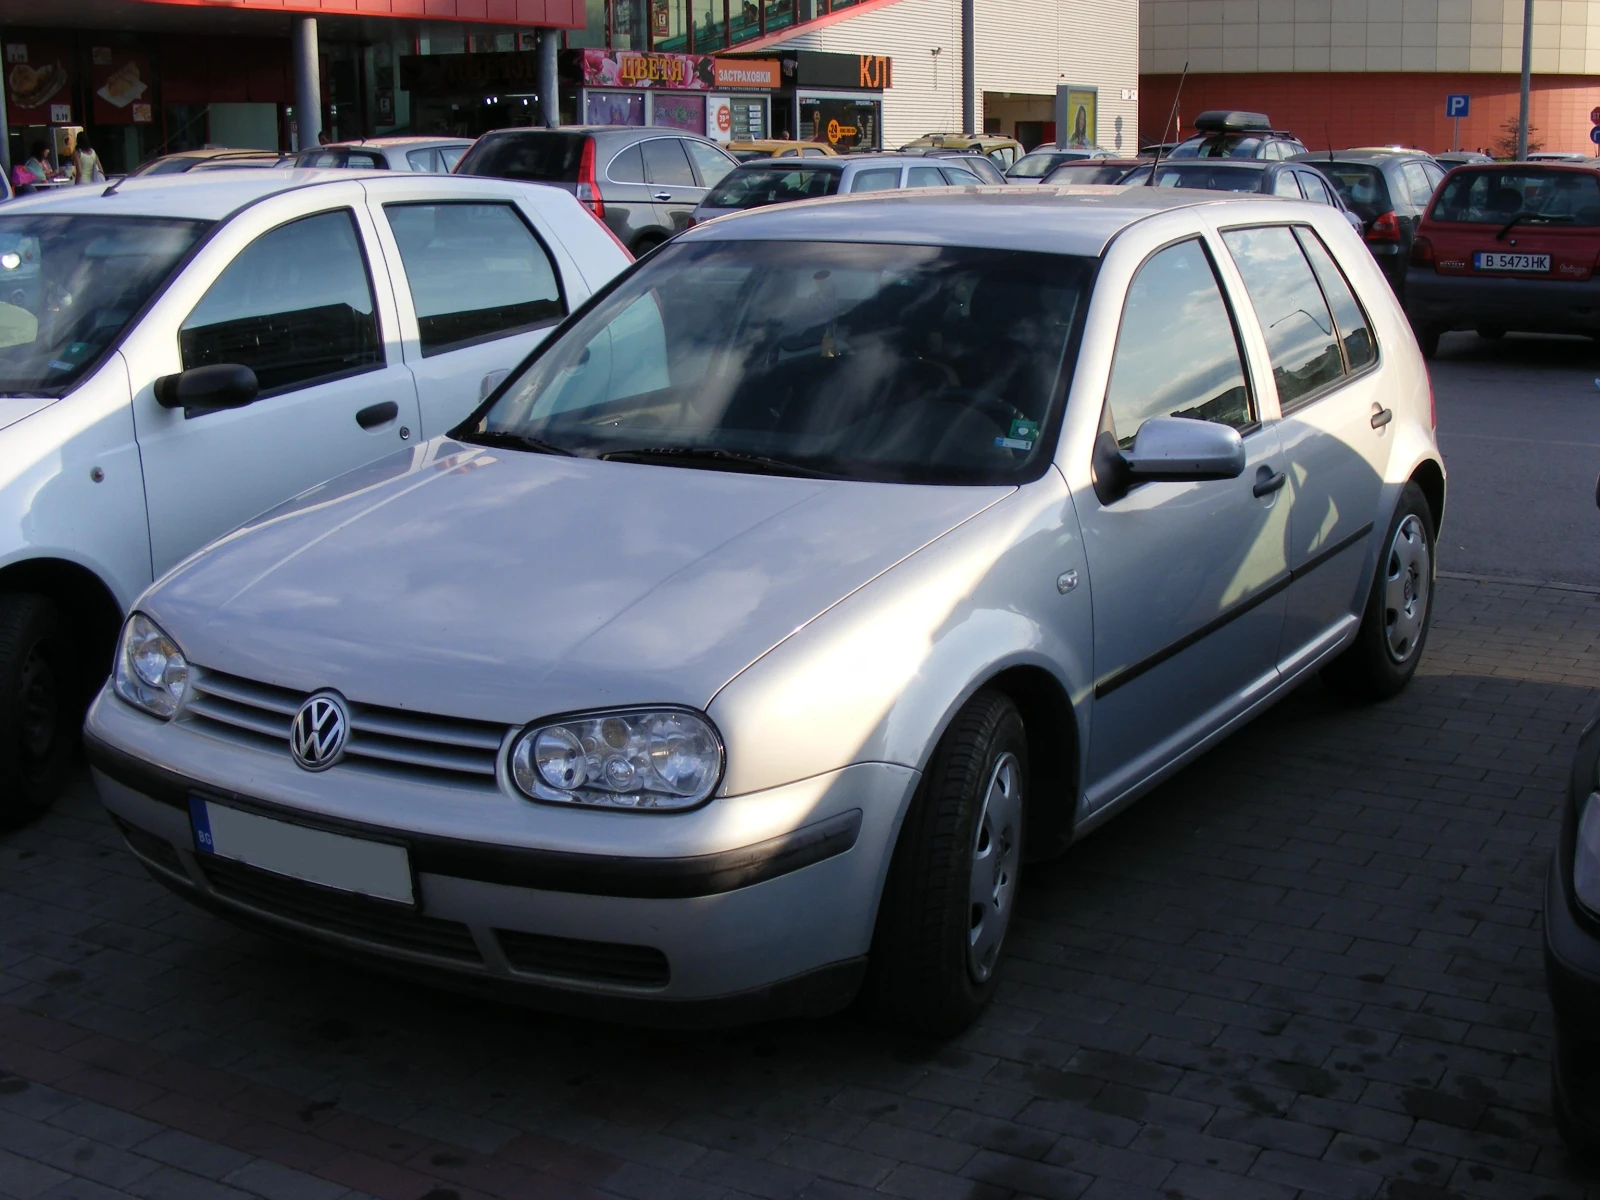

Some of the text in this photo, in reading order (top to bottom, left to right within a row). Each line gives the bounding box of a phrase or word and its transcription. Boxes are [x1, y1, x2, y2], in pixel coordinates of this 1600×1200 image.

[621, 56, 683, 84] ЦВЕТЯ
[718, 70, 771, 83] ЗАСТРАХОВКИ
[1451, 97, 1465, 116] P
[198, 830, 212, 845] BG
